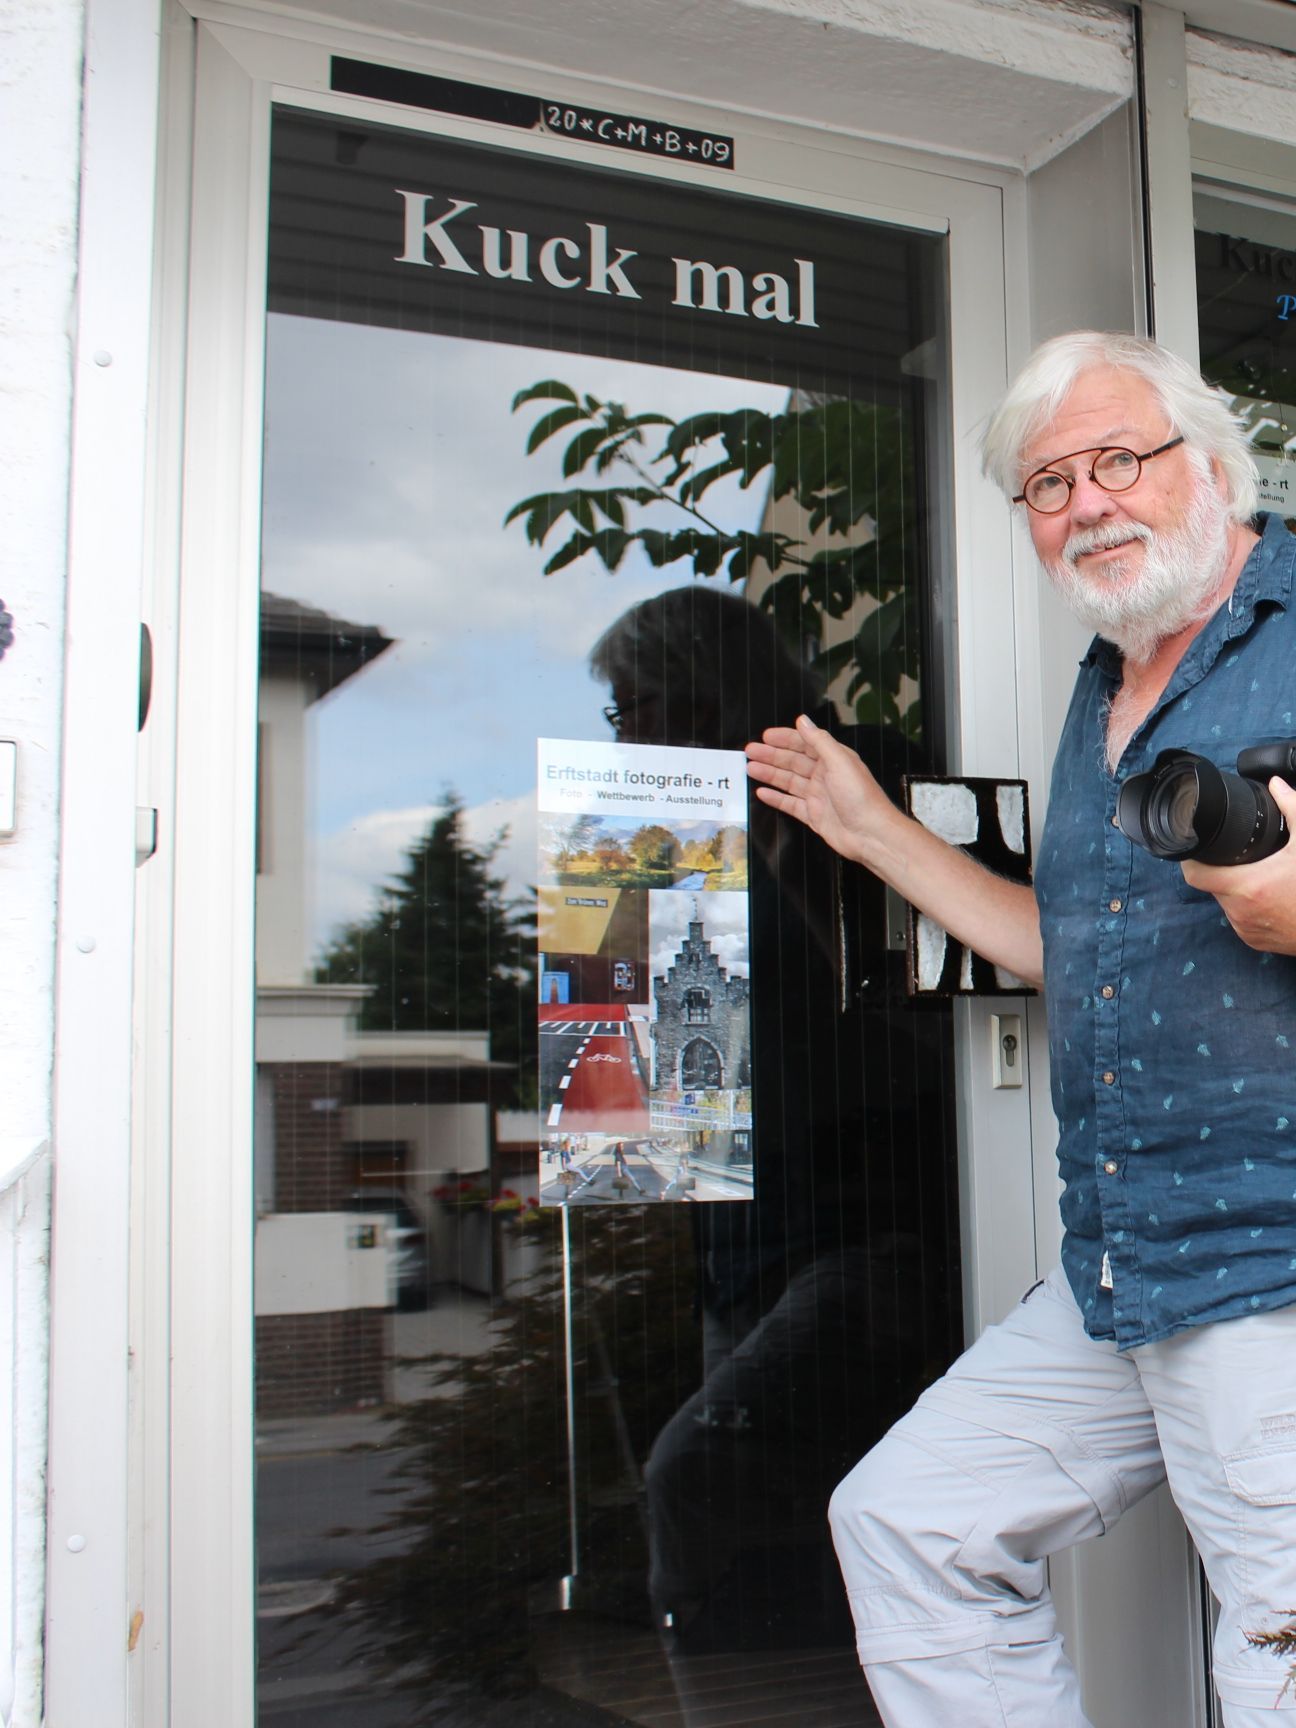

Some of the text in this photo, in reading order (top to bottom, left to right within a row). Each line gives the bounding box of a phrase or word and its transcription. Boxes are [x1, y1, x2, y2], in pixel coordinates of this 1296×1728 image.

[394, 189, 820, 328] Kuck mal
[546, 764, 619, 784] Erftstadt
[624, 769, 702, 789] fotografie
[718, 776, 730, 790] rt
[560, 788, 582, 799] Foto
[597, 790, 655, 802] Wettbewerb
[666, 794, 723, 807] Ausstellung
